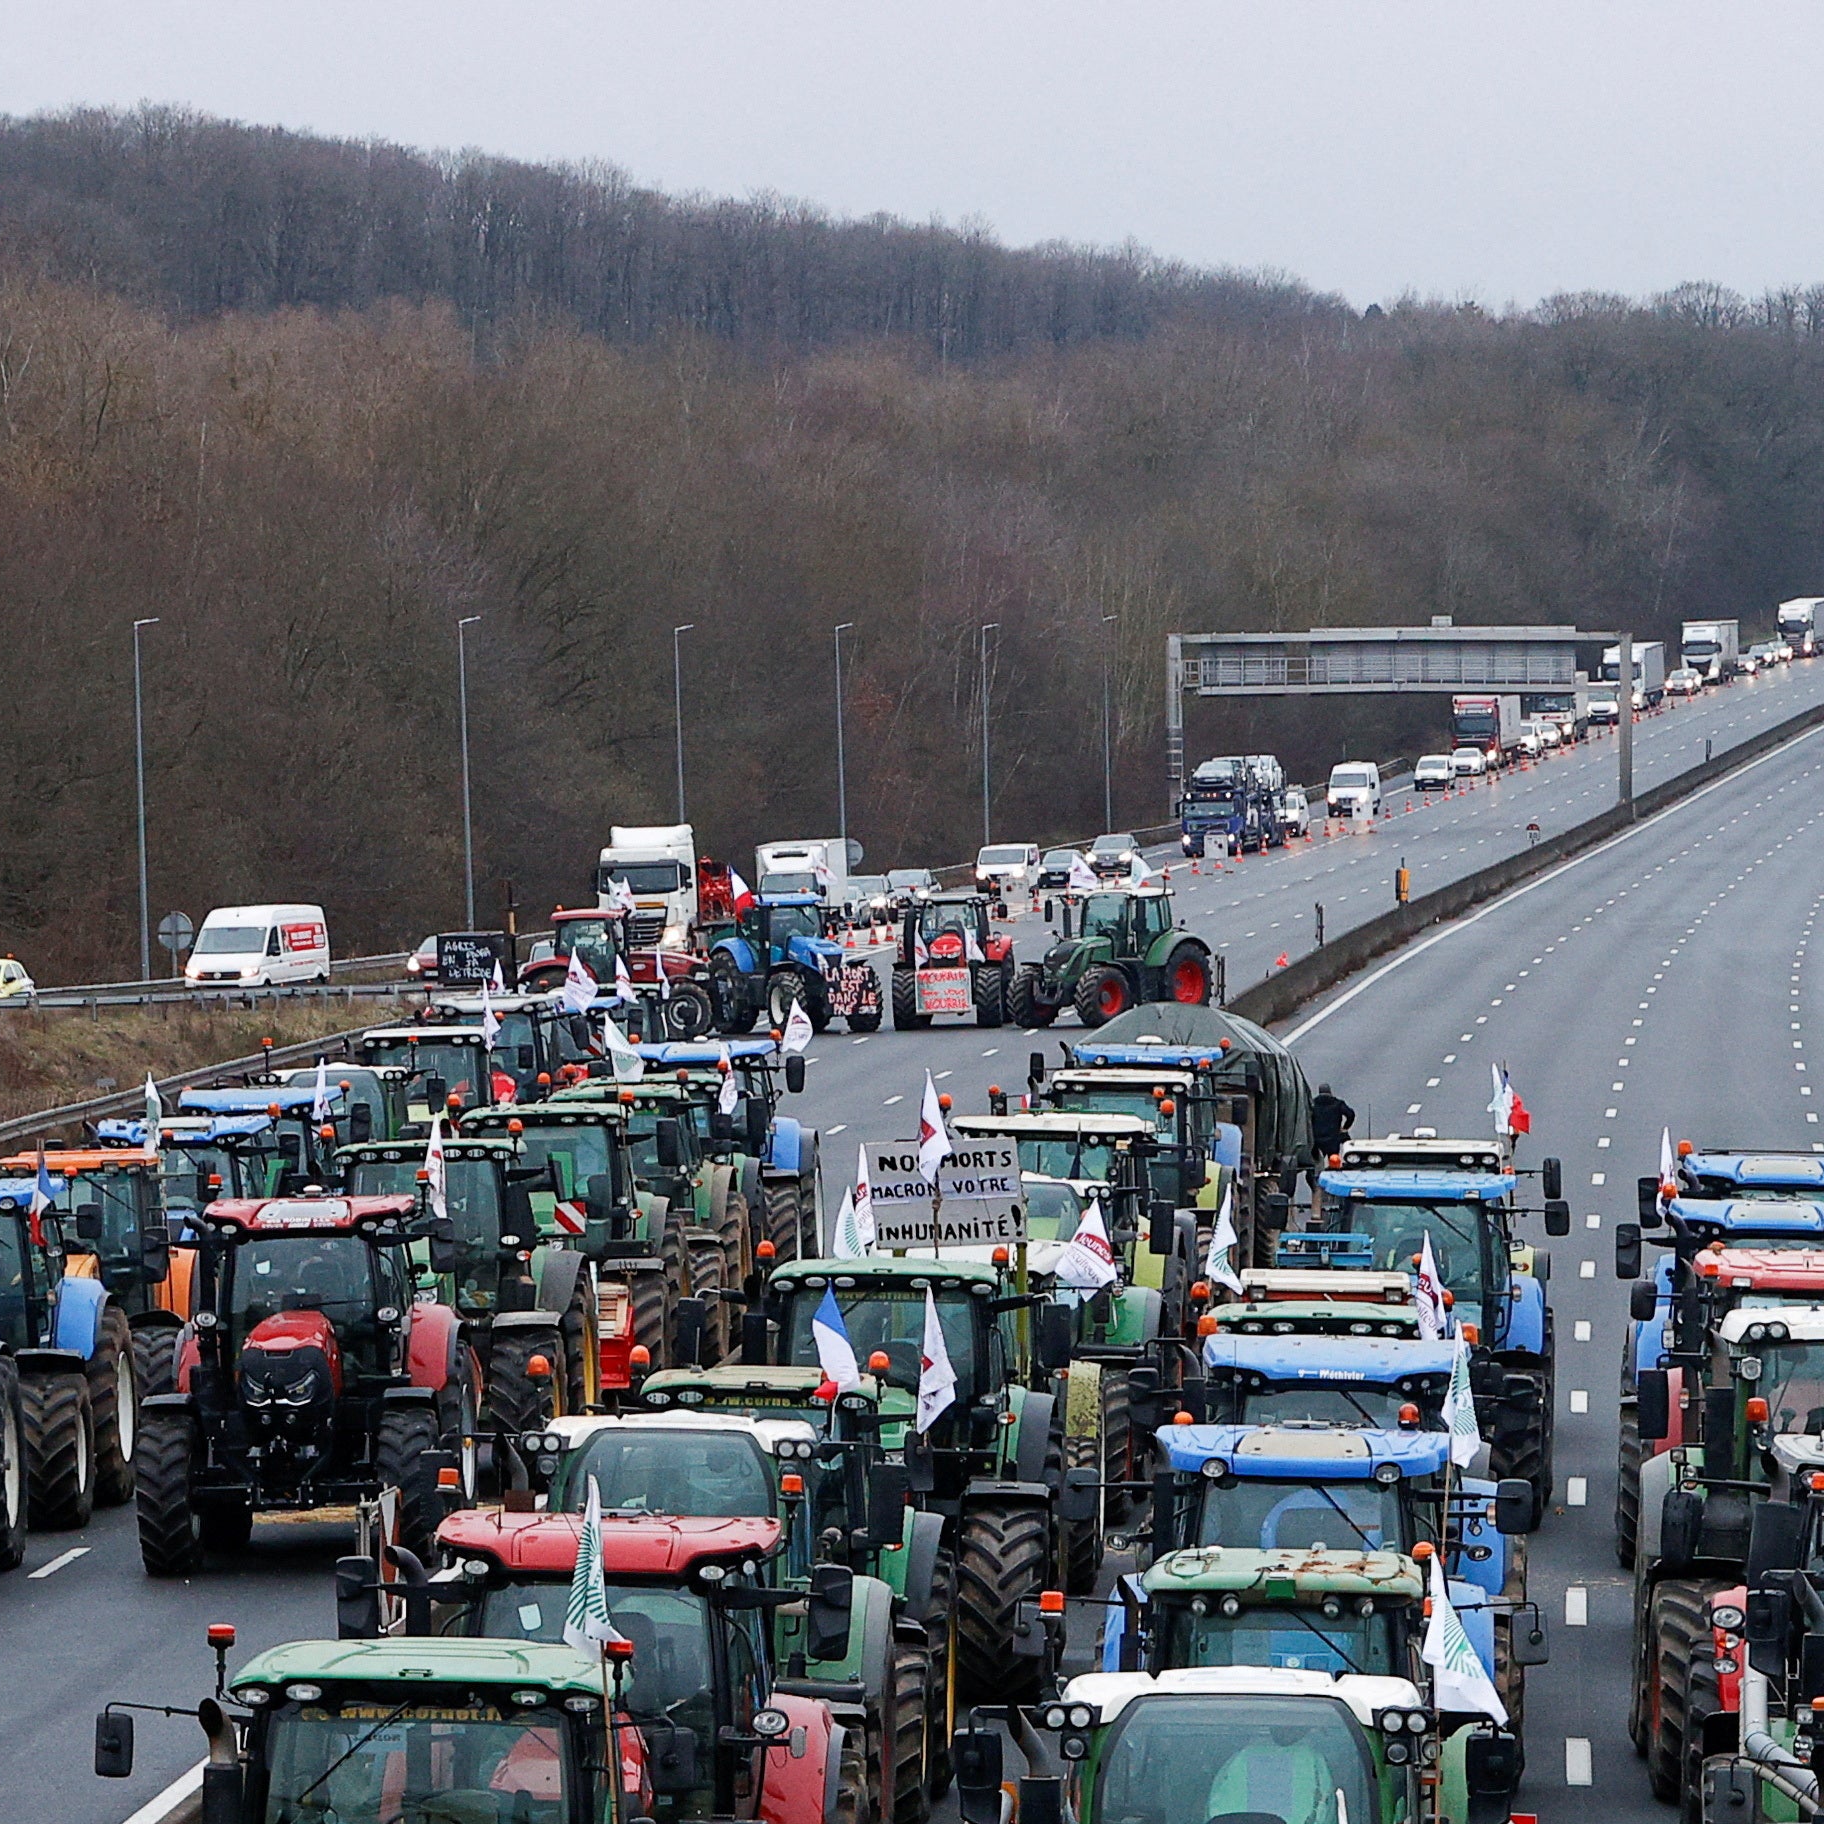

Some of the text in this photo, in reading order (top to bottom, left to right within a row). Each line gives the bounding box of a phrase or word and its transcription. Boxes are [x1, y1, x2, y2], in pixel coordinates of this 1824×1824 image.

[940, 1150, 1012, 1169] MORTS
[871, 1177, 1011, 1199] MACRON VOTRE
